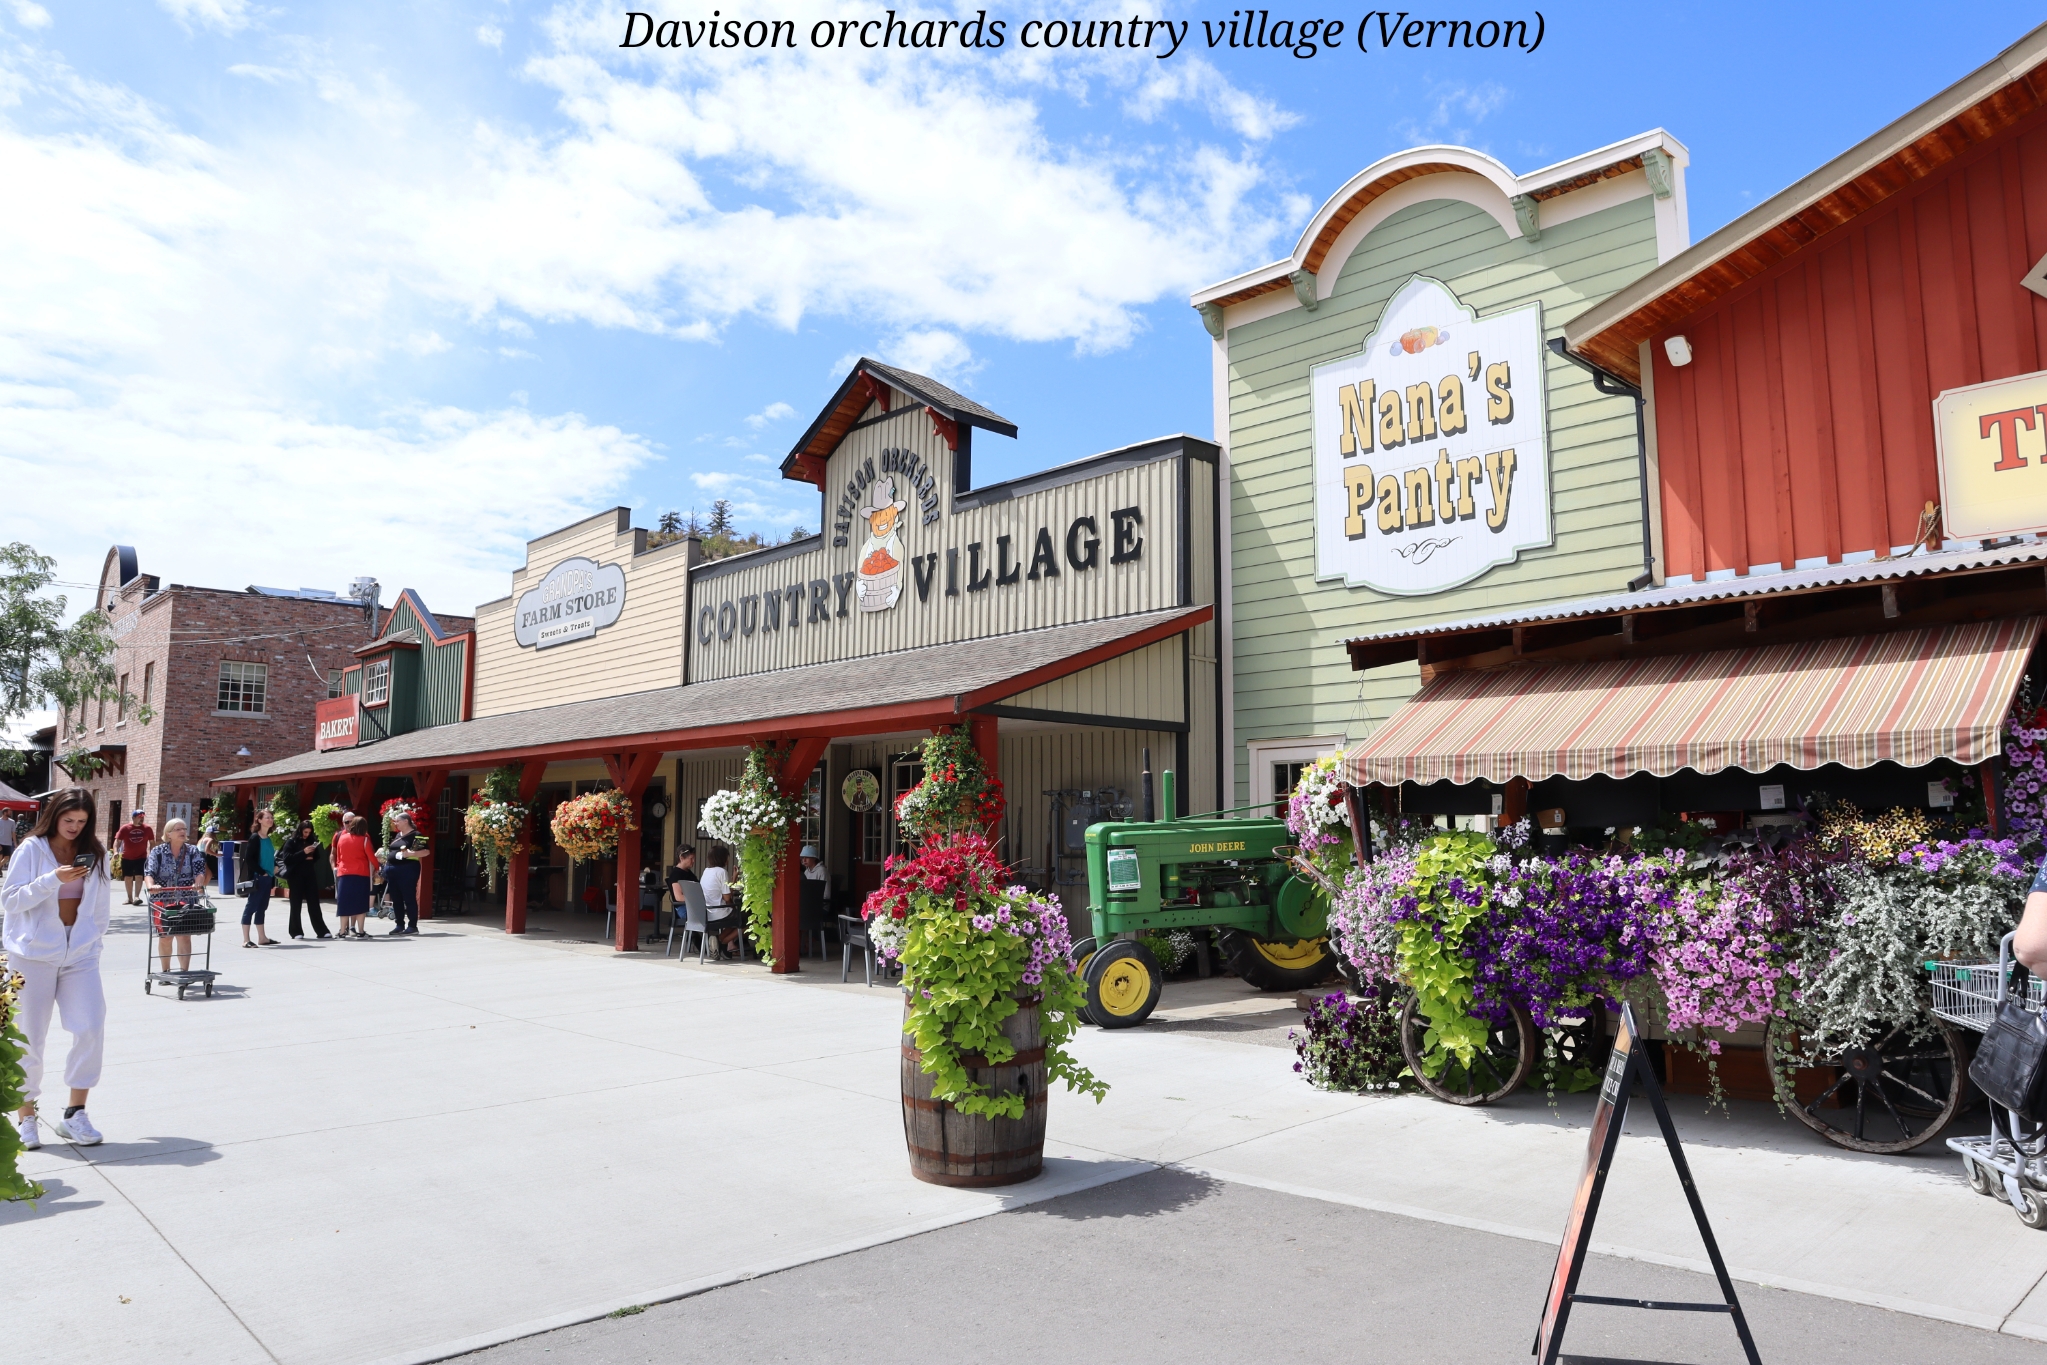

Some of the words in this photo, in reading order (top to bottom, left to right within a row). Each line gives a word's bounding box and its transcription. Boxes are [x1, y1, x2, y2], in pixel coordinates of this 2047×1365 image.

[1339, 350, 1514, 459] Nana's
[1979, 403, 2047, 472] T
[833, 457, 875, 547] DAVISON
[882, 448, 939, 526] ORCHARDS
[1343, 448, 1517, 541] Pantry
[542, 569, 593, 604] GRANDPA'S
[697, 572, 855, 645] COUNTRY
[911, 506, 1143, 602] VILLAGE
[521, 603, 562, 628] FARM
[565, 587, 617, 617] STORE
[541, 627, 562, 639] Sweets
[563, 625, 569, 633] &
[570, 620, 591, 632] Treats
[320, 716, 355, 740] BAKERY
[1189, 843, 1214, 853] JOHN
[1216, 841, 1246, 852] DEERE
